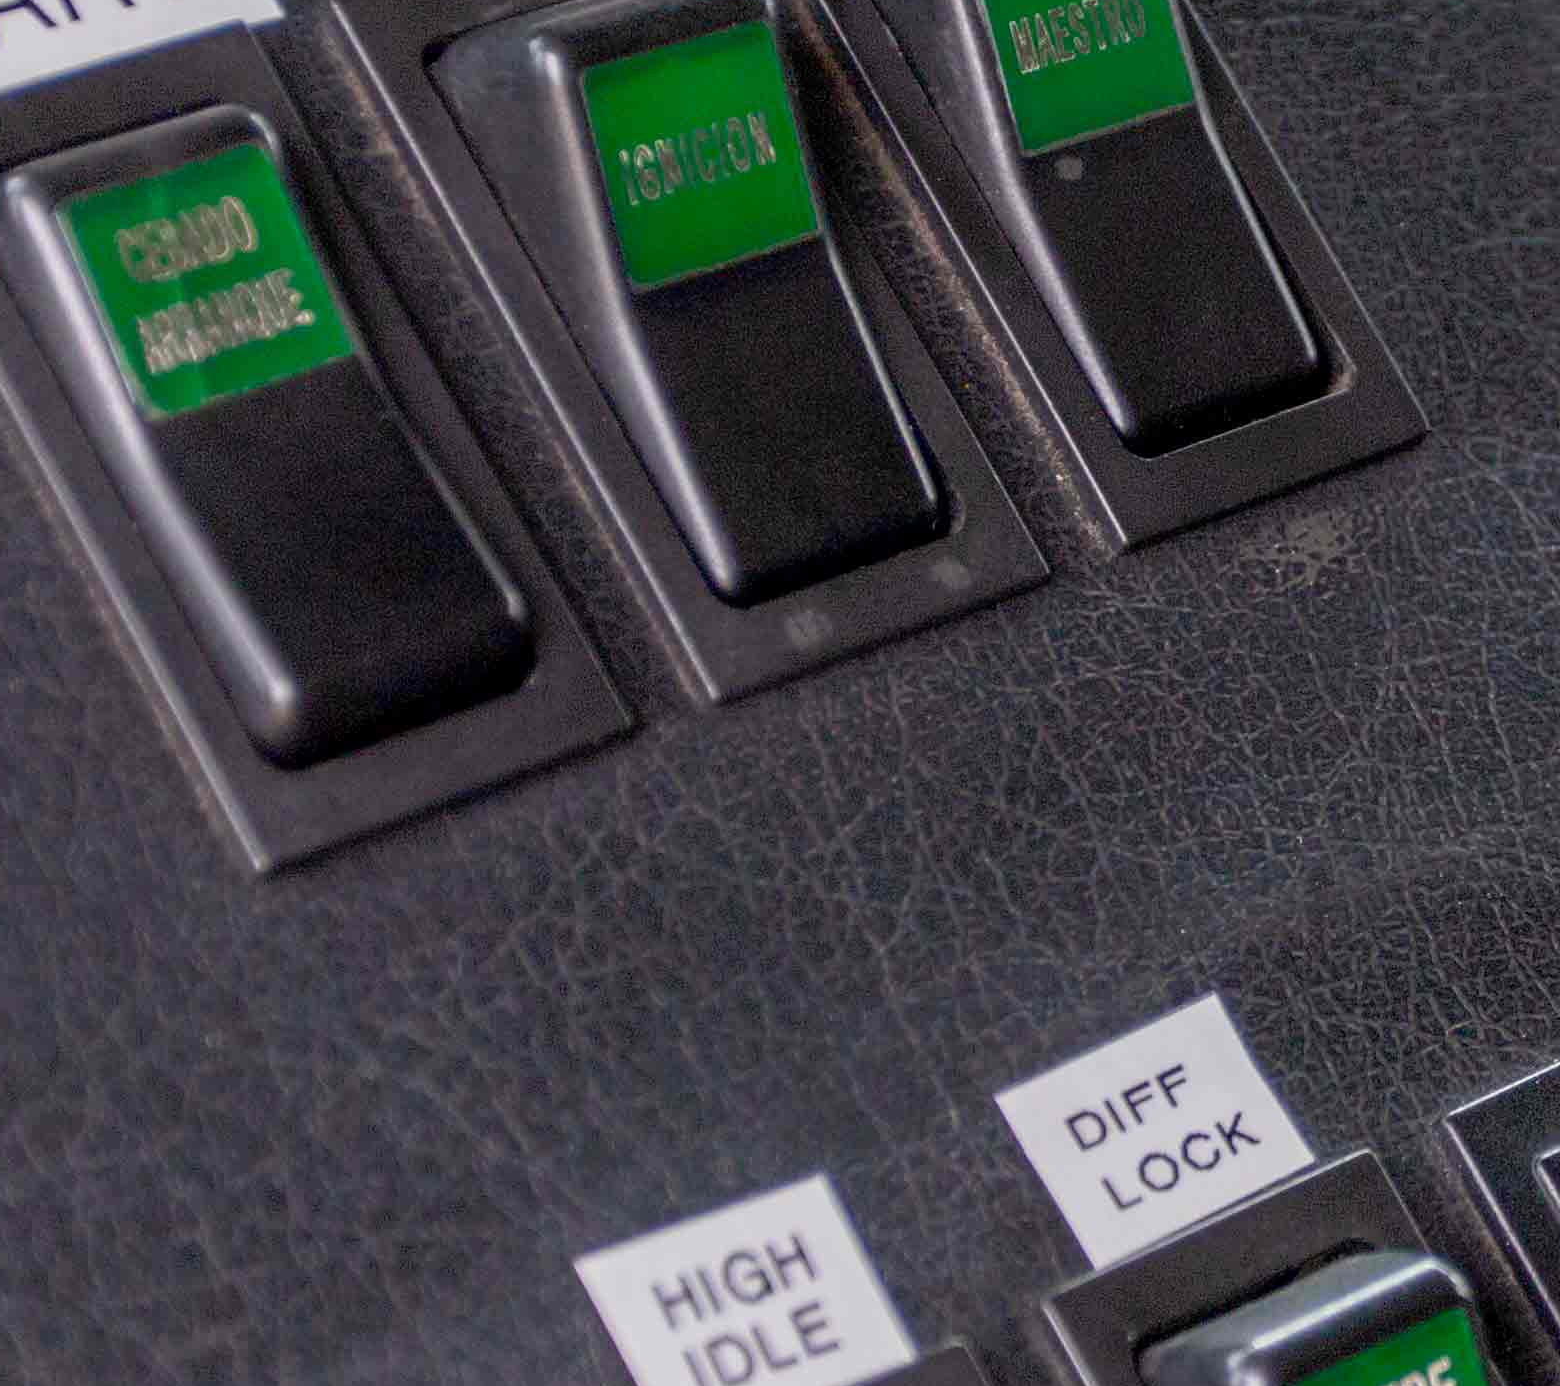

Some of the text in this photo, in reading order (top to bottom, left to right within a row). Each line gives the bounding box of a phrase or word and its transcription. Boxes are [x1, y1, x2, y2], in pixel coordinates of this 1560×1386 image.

[618, 111, 777, 205] IGNICION
[1064, 1065, 1191, 1151] DIFF
[1101, 1111, 1261, 1212] LOCK
[653, 1233, 820, 1330] HIGH
